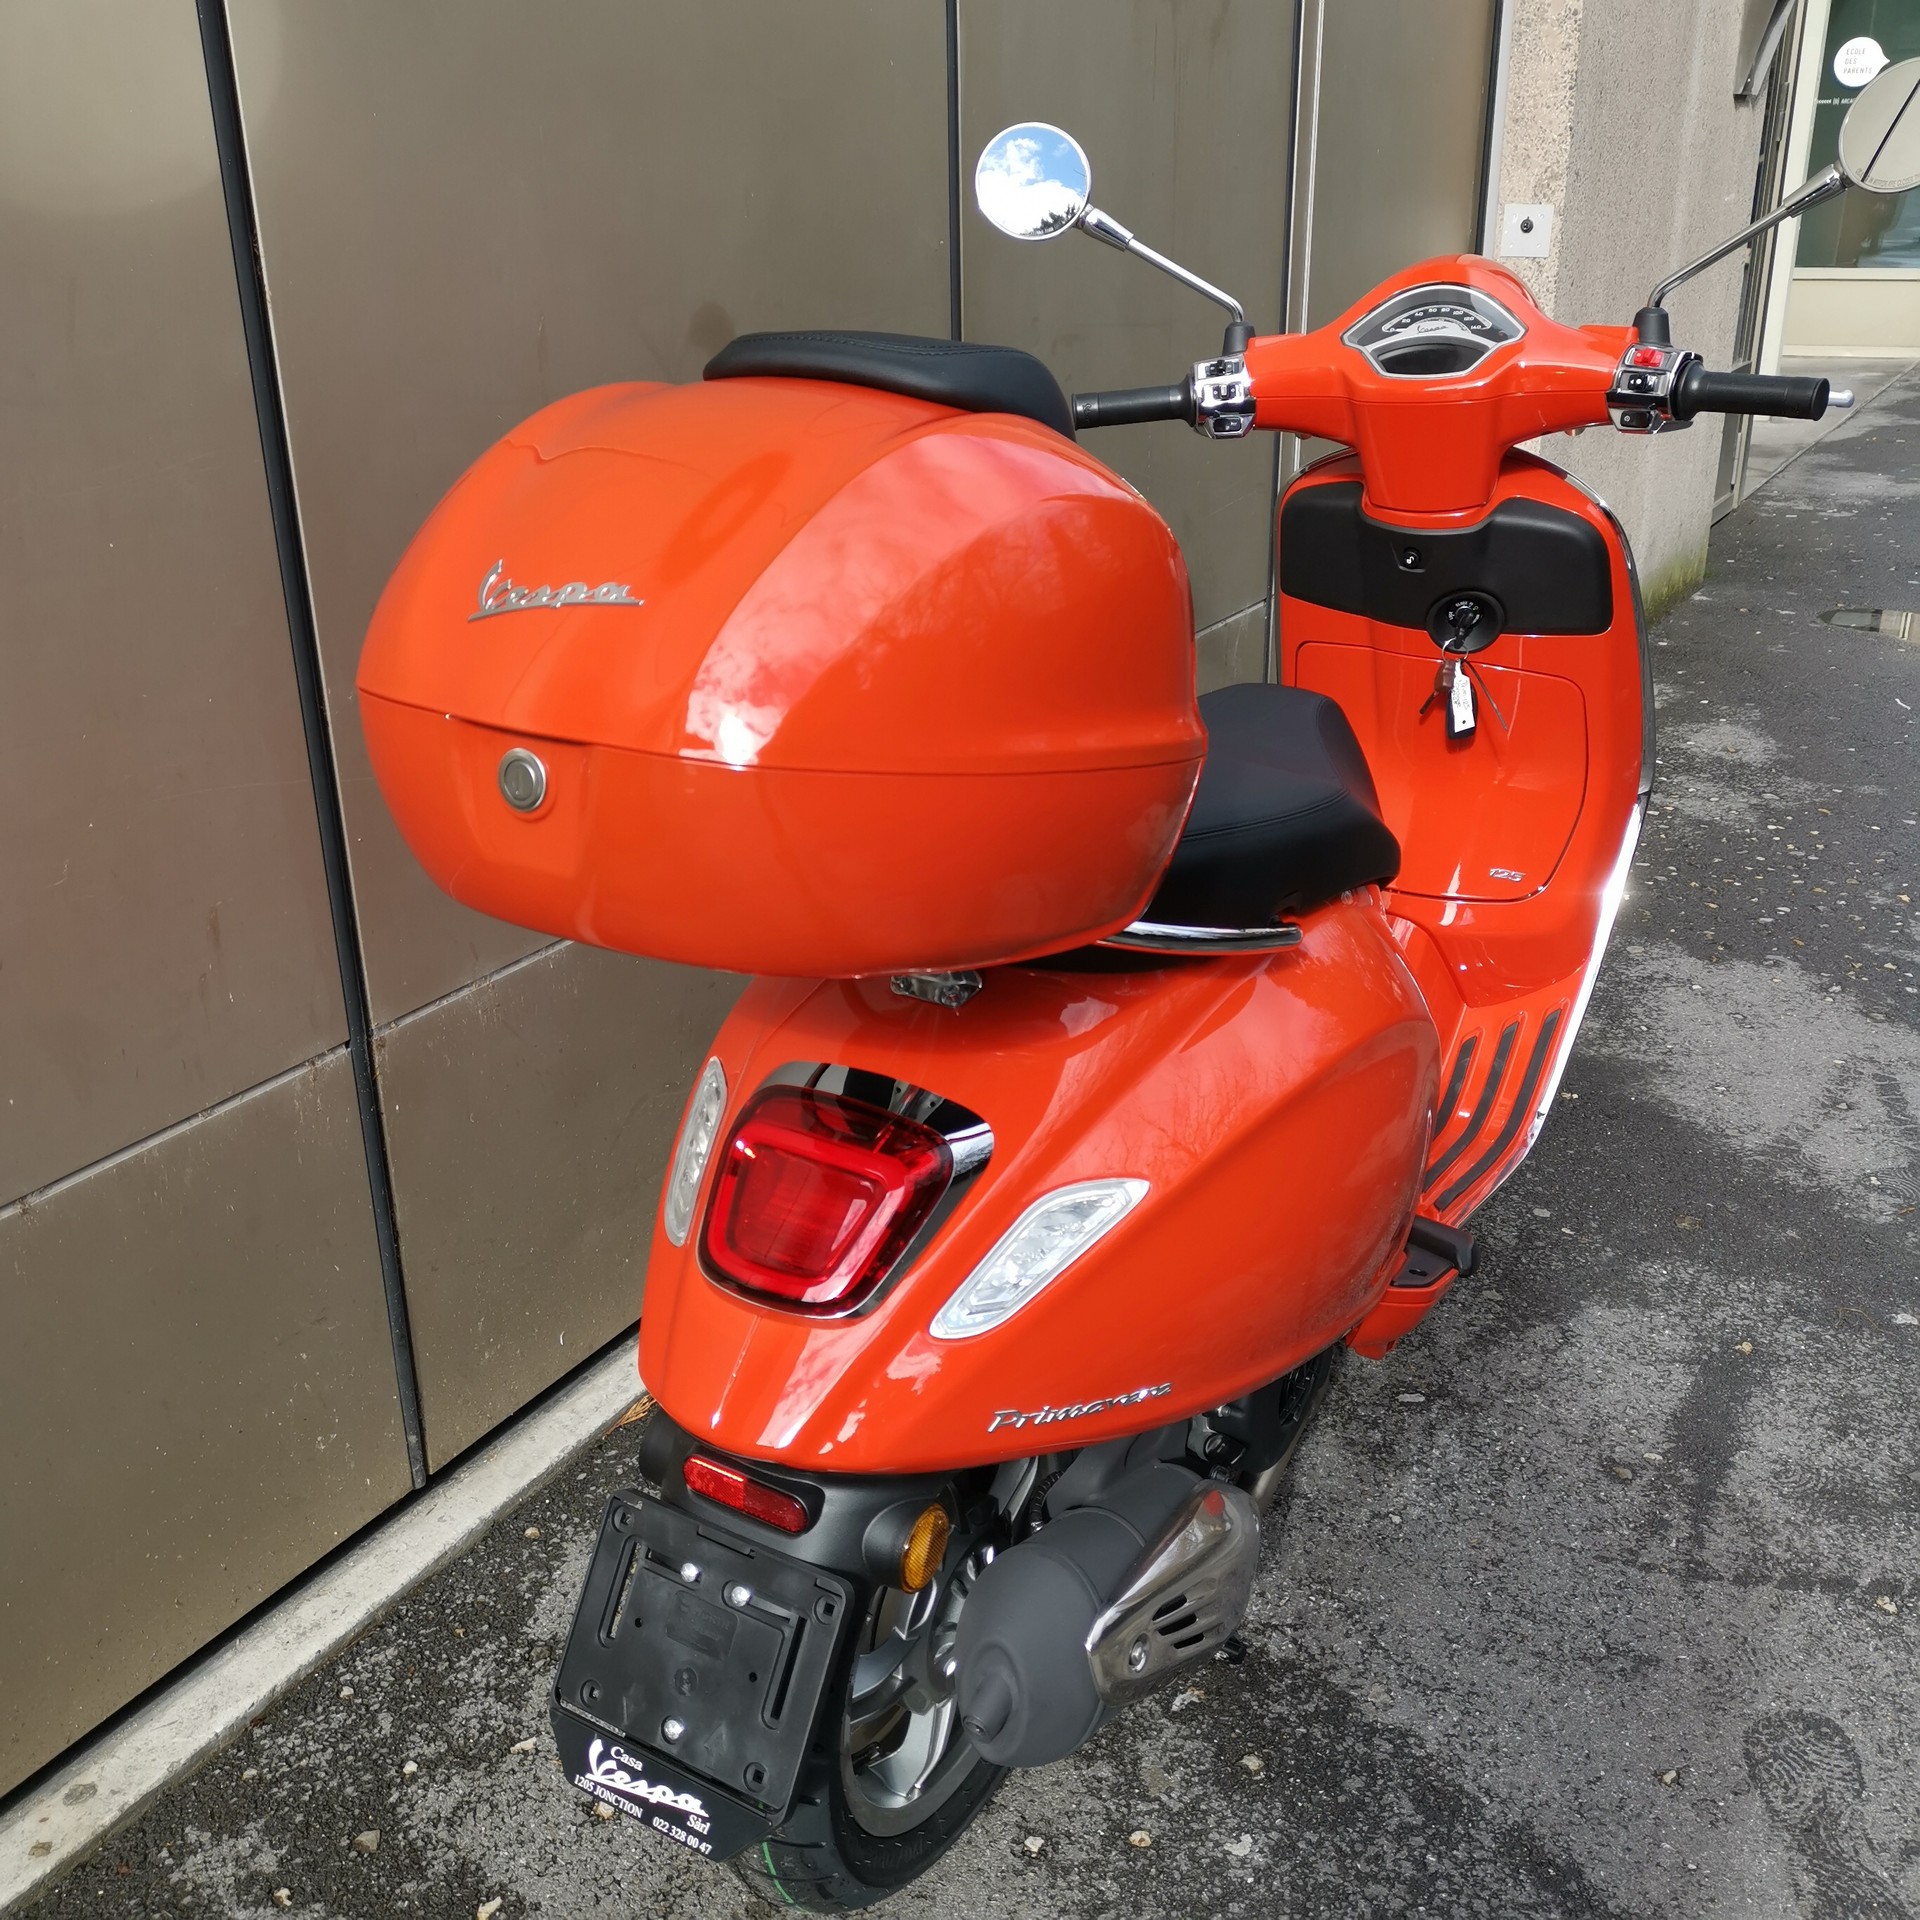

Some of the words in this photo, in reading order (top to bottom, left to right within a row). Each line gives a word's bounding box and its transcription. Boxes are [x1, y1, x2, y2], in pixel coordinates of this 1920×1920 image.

[1843, 67, 1873, 75] PARENTS
[1416, 324, 1448, 333] Vespa
[467, 558, 645, 623] Vespa
[1489, 867, 1527, 882] 125
[986, 1381, 1173, 1433] Primavera
[610, 1745, 644, 1772] Casa
[584, 1738, 710, 1819] Vespa
[574, 1774, 595, 1792] 1205
[593, 1782, 644, 1819] JONCTION
[652, 1816, 669, 1833] 022
[669, 1825, 687, 1842] 328
[686, 1834, 699, 1848] 00
[698, 1840, 713, 1855] 47
